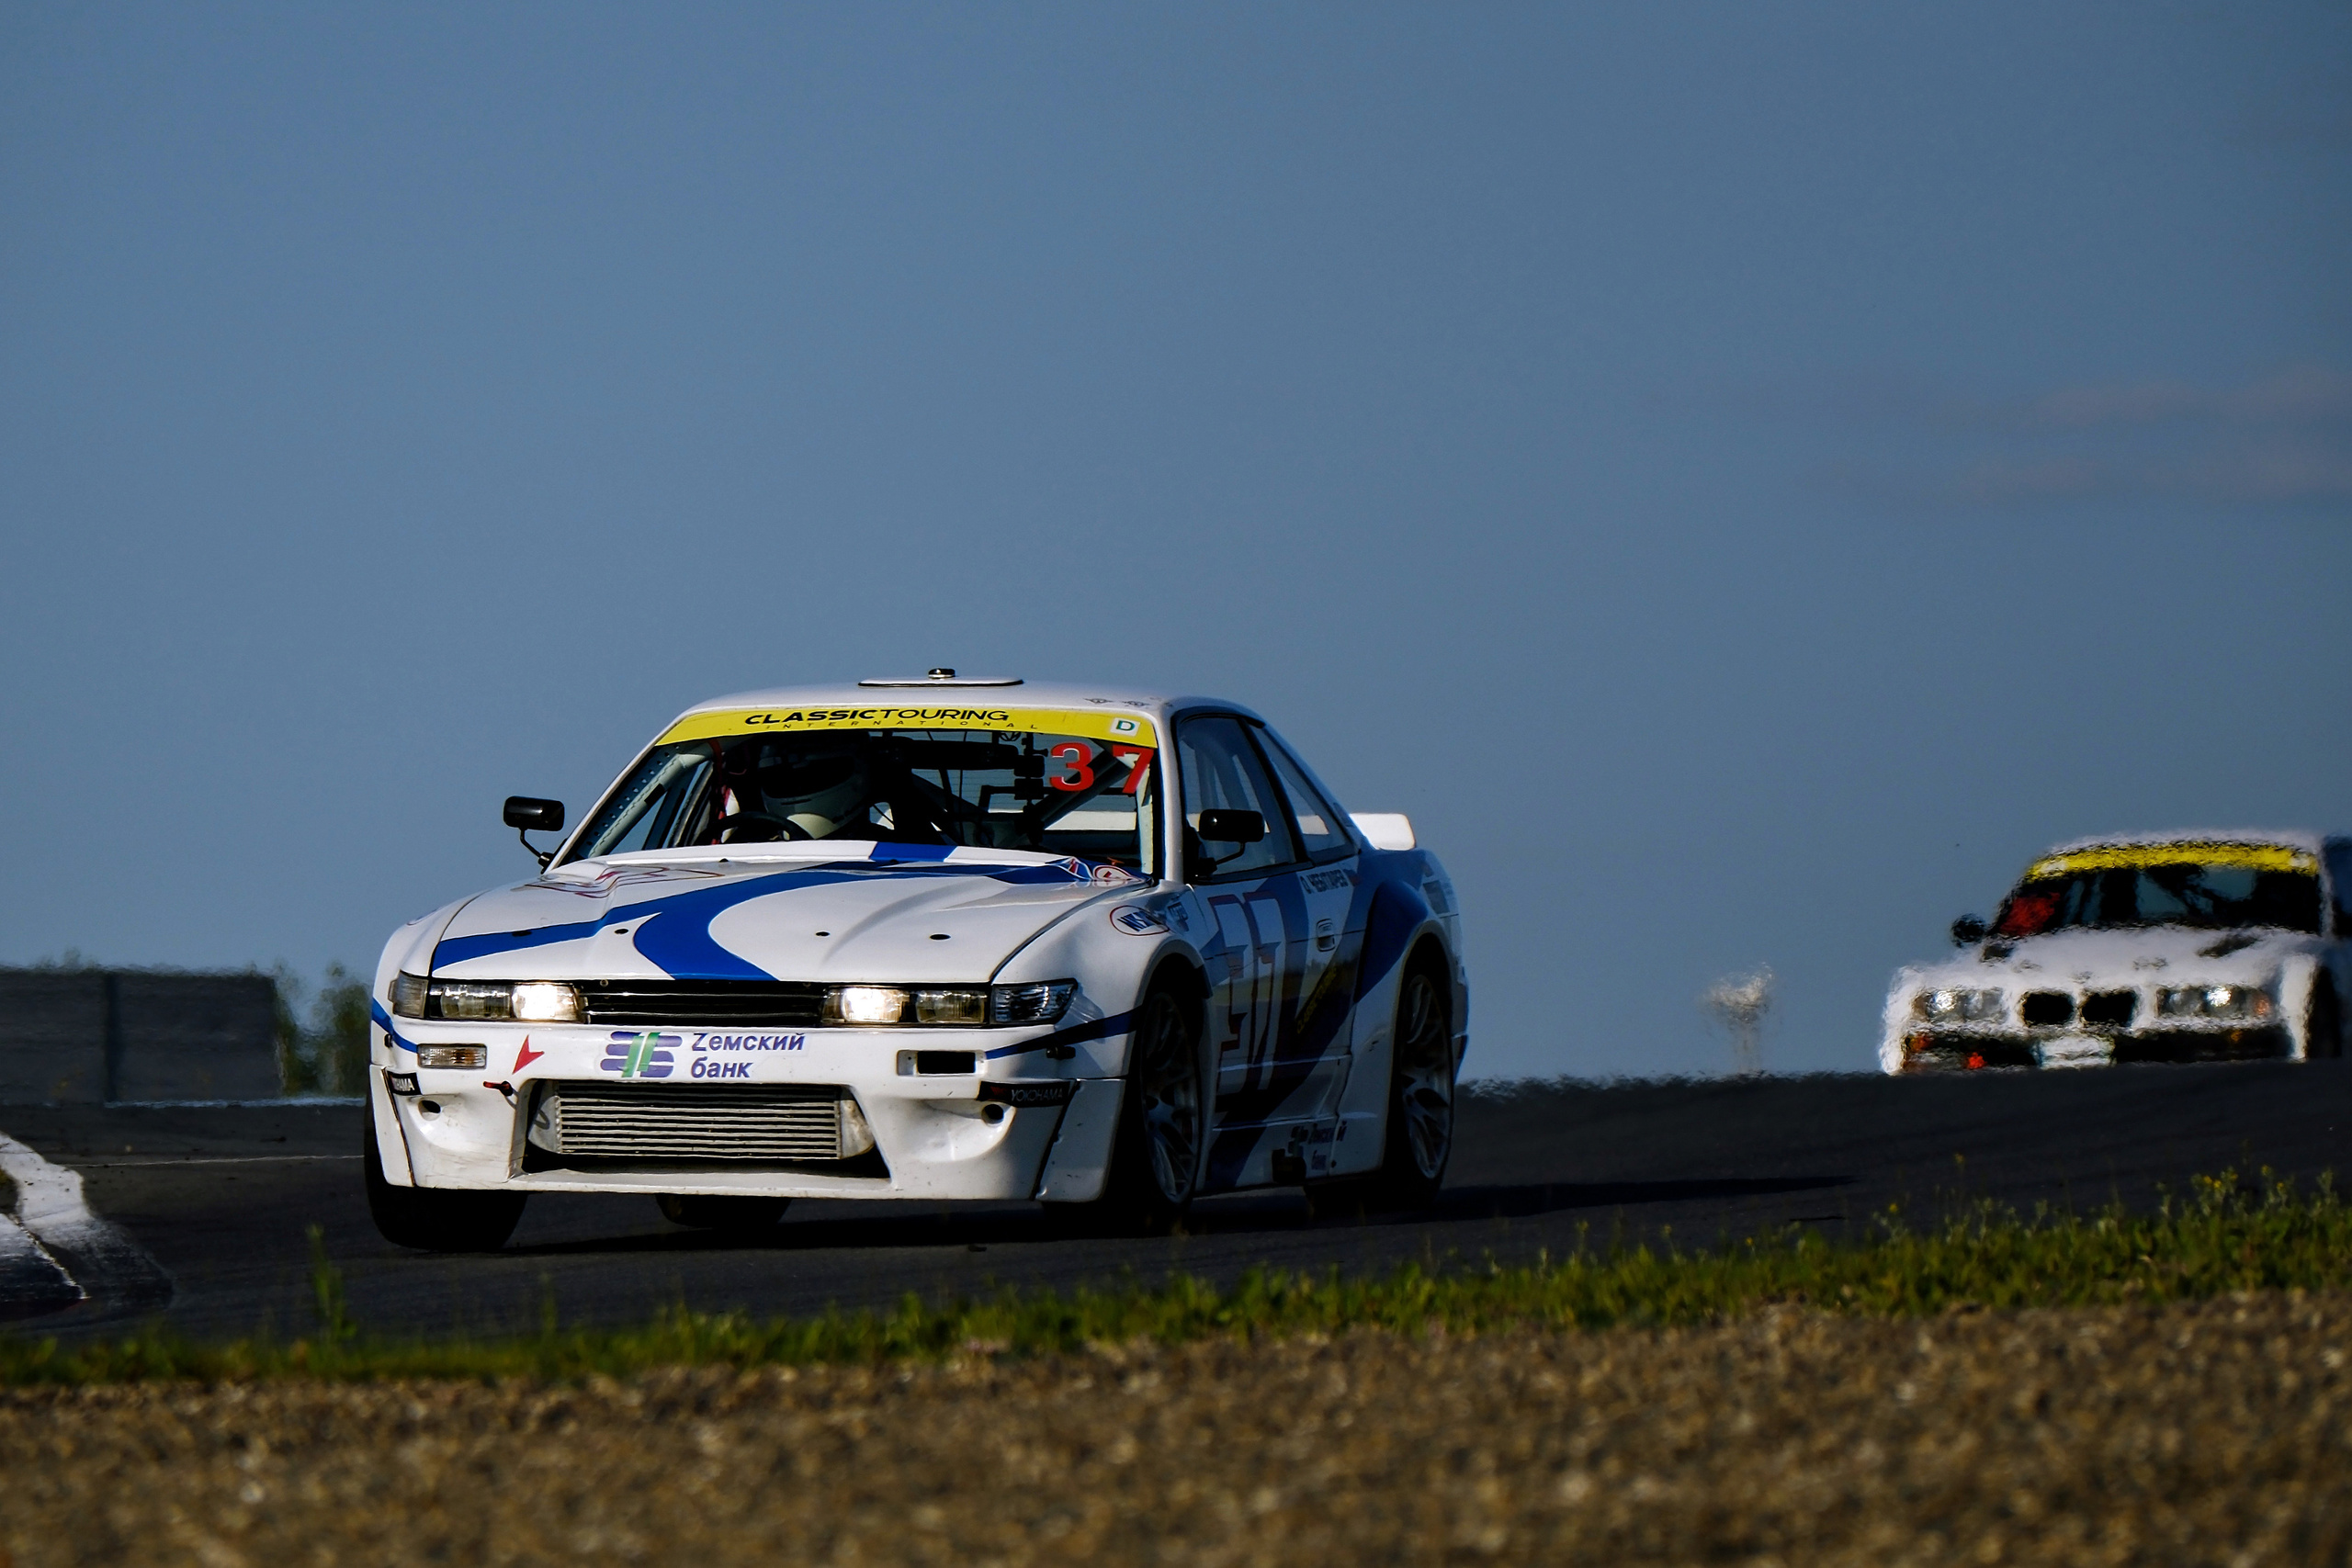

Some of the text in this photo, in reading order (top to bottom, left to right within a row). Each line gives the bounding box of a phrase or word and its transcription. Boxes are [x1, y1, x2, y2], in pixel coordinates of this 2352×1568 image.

[766, 720, 1037, 729] INTERNATIONAL
[1116, 720, 1136, 731] D
[1050, 742, 1154, 794] 37
[691, 1056, 753, 1077] банк
[1011, 1088, 1063, 1102] YOKOHAMA
